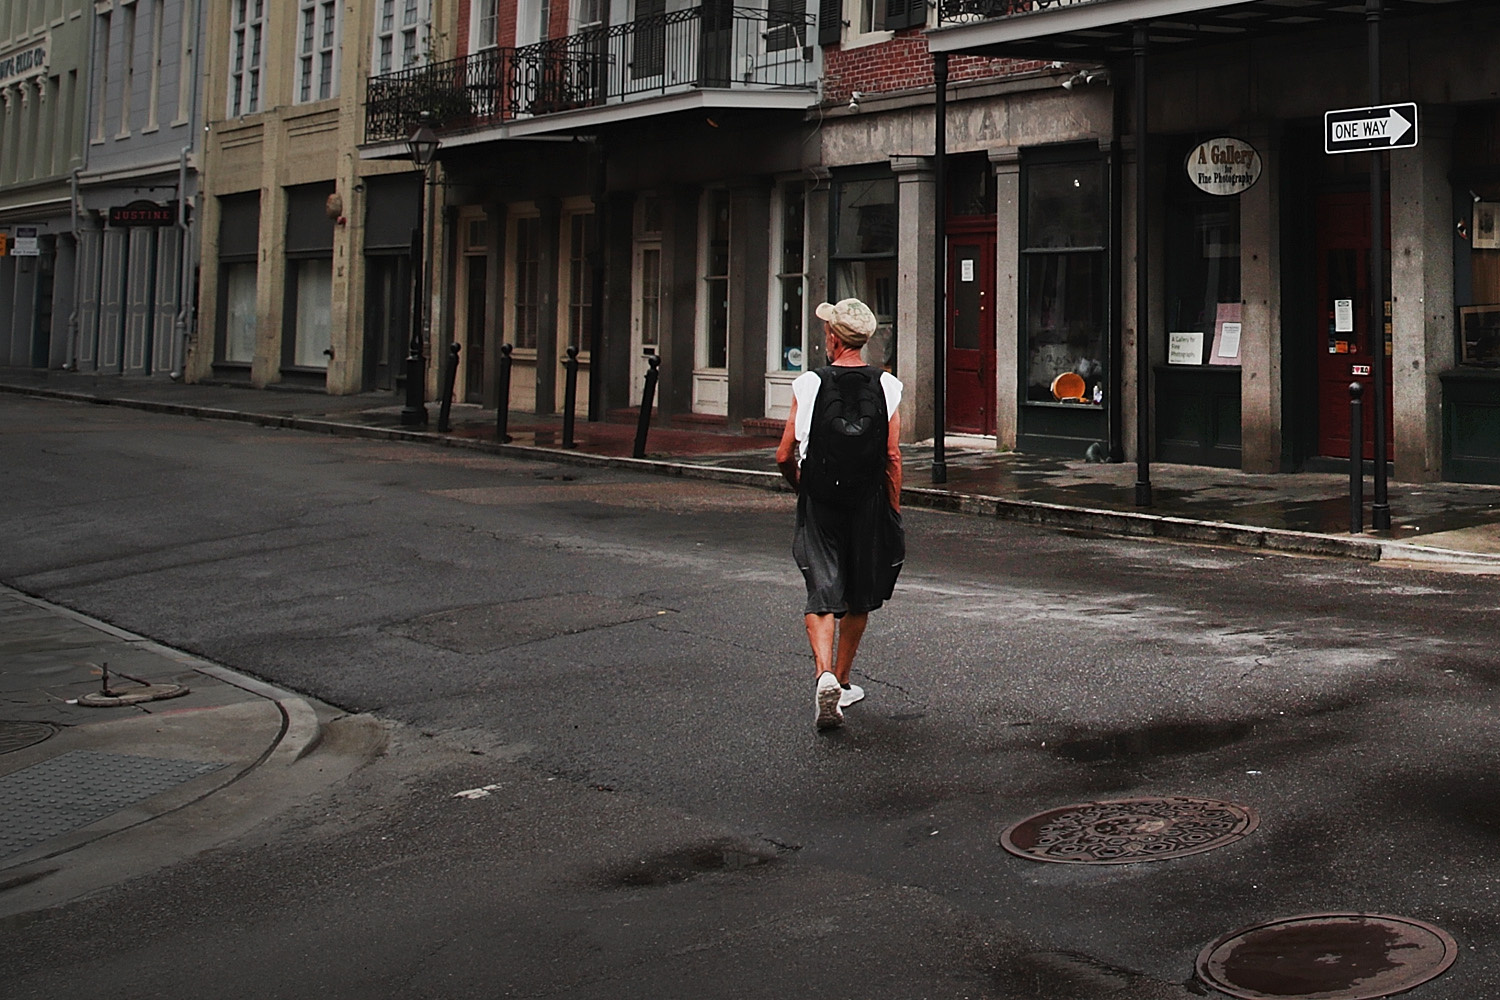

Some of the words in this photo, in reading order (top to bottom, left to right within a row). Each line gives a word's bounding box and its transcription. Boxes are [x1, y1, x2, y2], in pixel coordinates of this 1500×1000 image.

[1335, 122, 1358, 139] ONE
[1363, 120, 1387, 136] WAY
[1198, 146, 1207, 164] A
[1211, 145, 1254, 169] Gallery
[1198, 173, 1211, 184] Fine
[1214, 172, 1253, 186] Photography
[114, 210, 170, 220] JUSTINE
